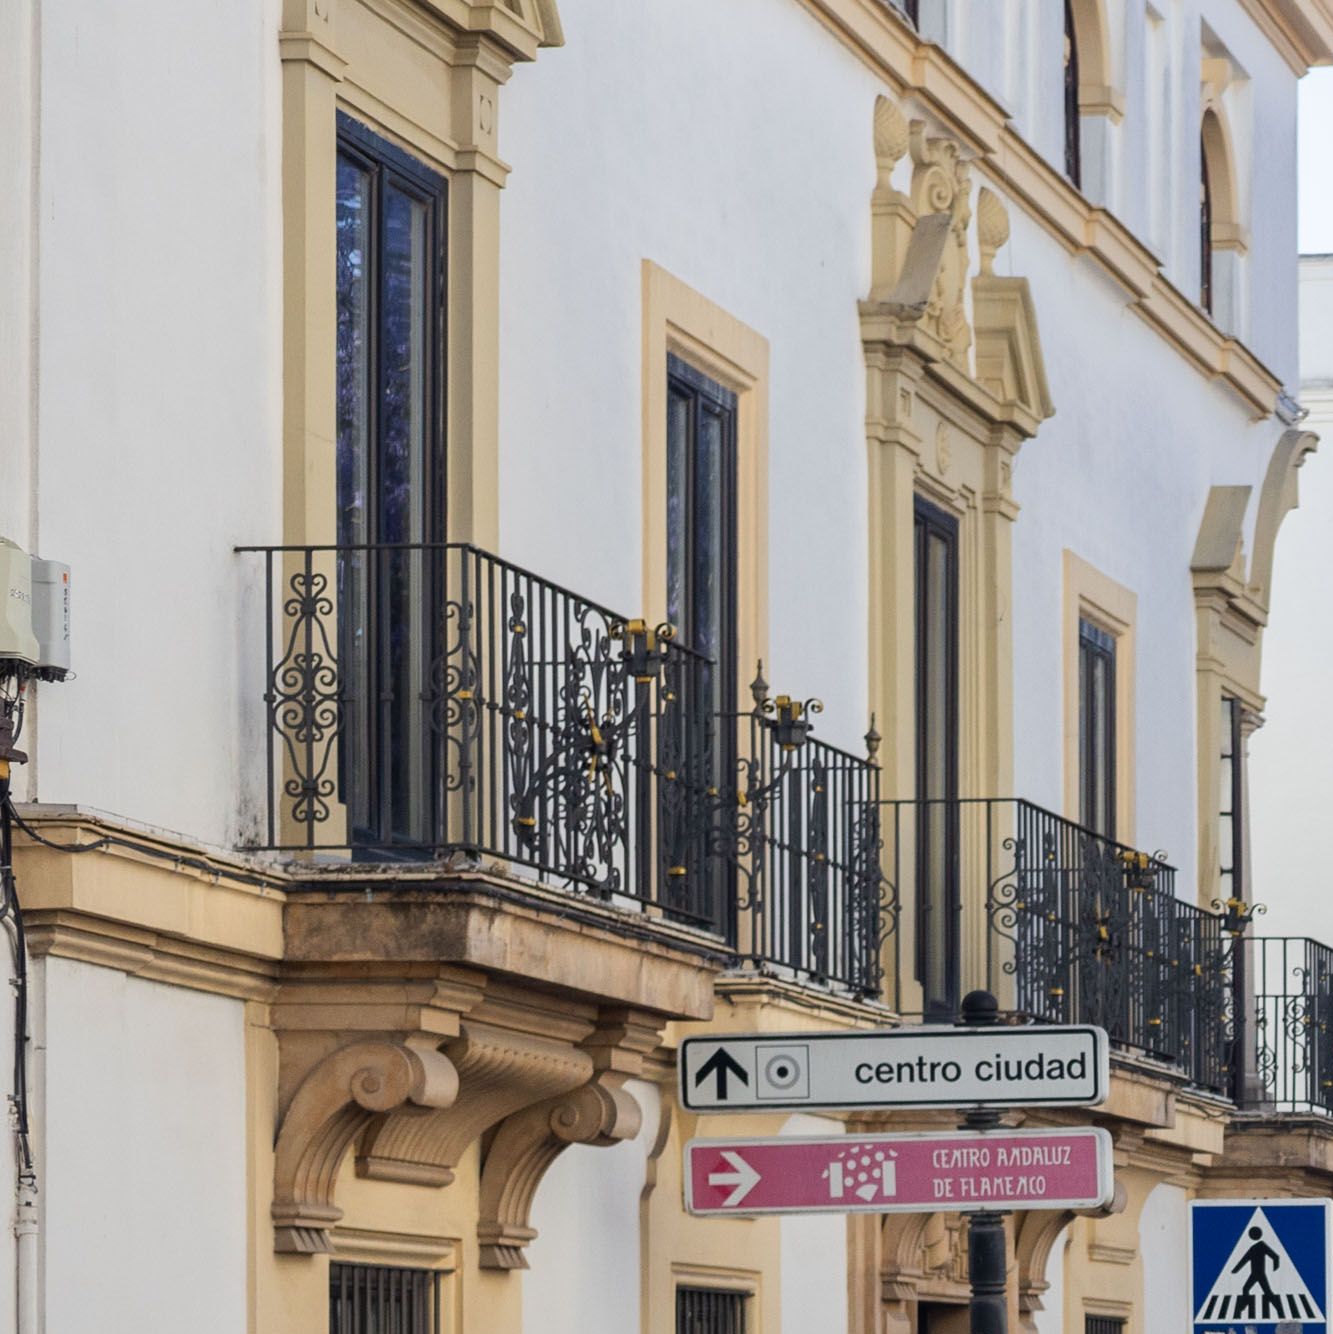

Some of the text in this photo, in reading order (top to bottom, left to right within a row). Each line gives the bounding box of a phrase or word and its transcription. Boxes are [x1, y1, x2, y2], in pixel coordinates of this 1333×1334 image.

[854, 1051, 1087, 1084] centro ciudad
[932, 1145, 1072, 1169] CENTRO ANDALUZ
[932, 1175, 1047, 1198] DE FLAMENCO
